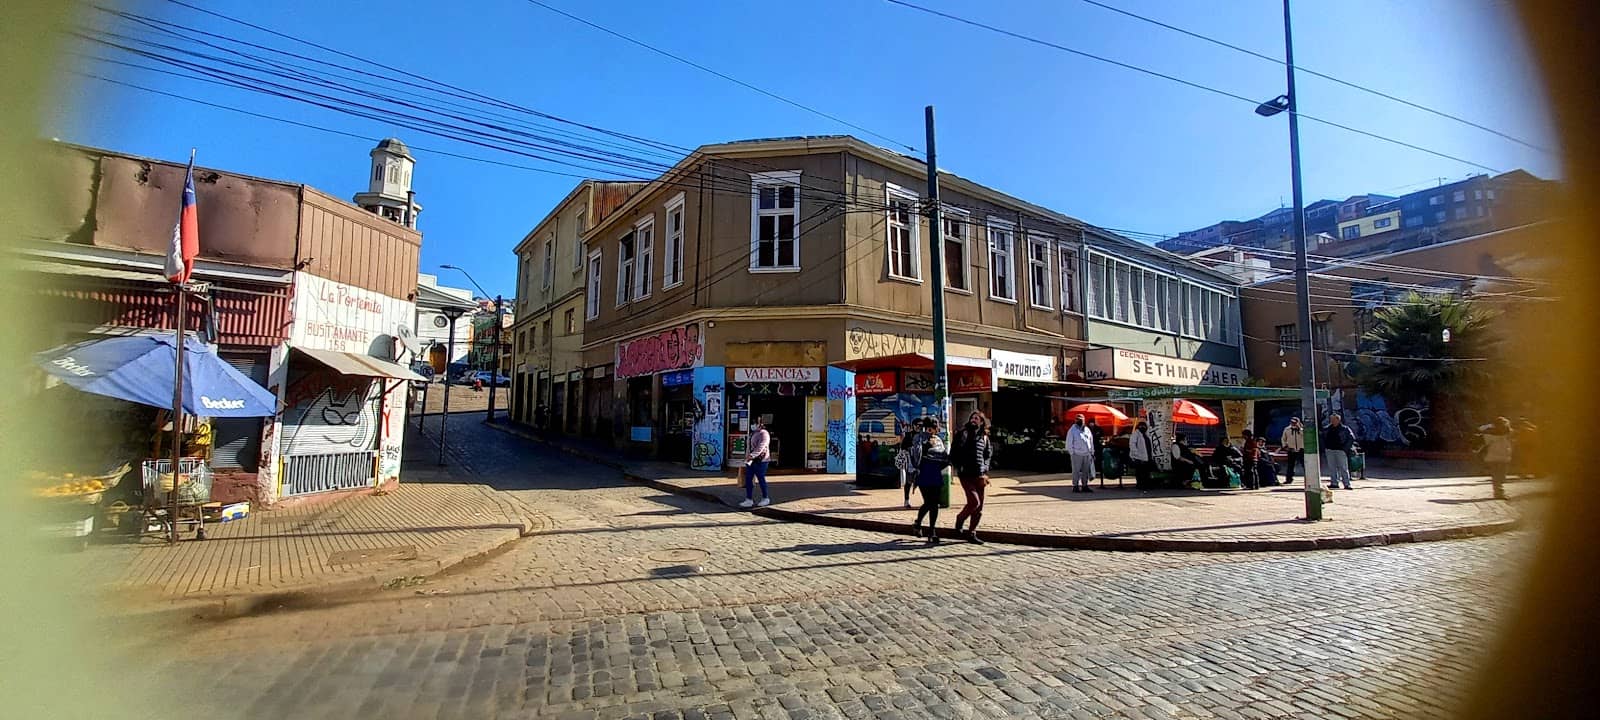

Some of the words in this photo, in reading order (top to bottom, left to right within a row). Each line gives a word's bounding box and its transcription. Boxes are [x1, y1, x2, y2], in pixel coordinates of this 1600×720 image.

[320, 281, 334, 303] La
[337, 284, 383, 315] Porteñita
[307, 322, 368, 344] BUSTAMANTE
[1119, 350, 1149, 361] CECINAS
[744, 368, 804, 380] VALENCIA
[1005, 362, 1041, 378] ARTURITO
[1133, 359, 1239, 385] SETHMACHER
[201, 396, 245, 410] Becker
